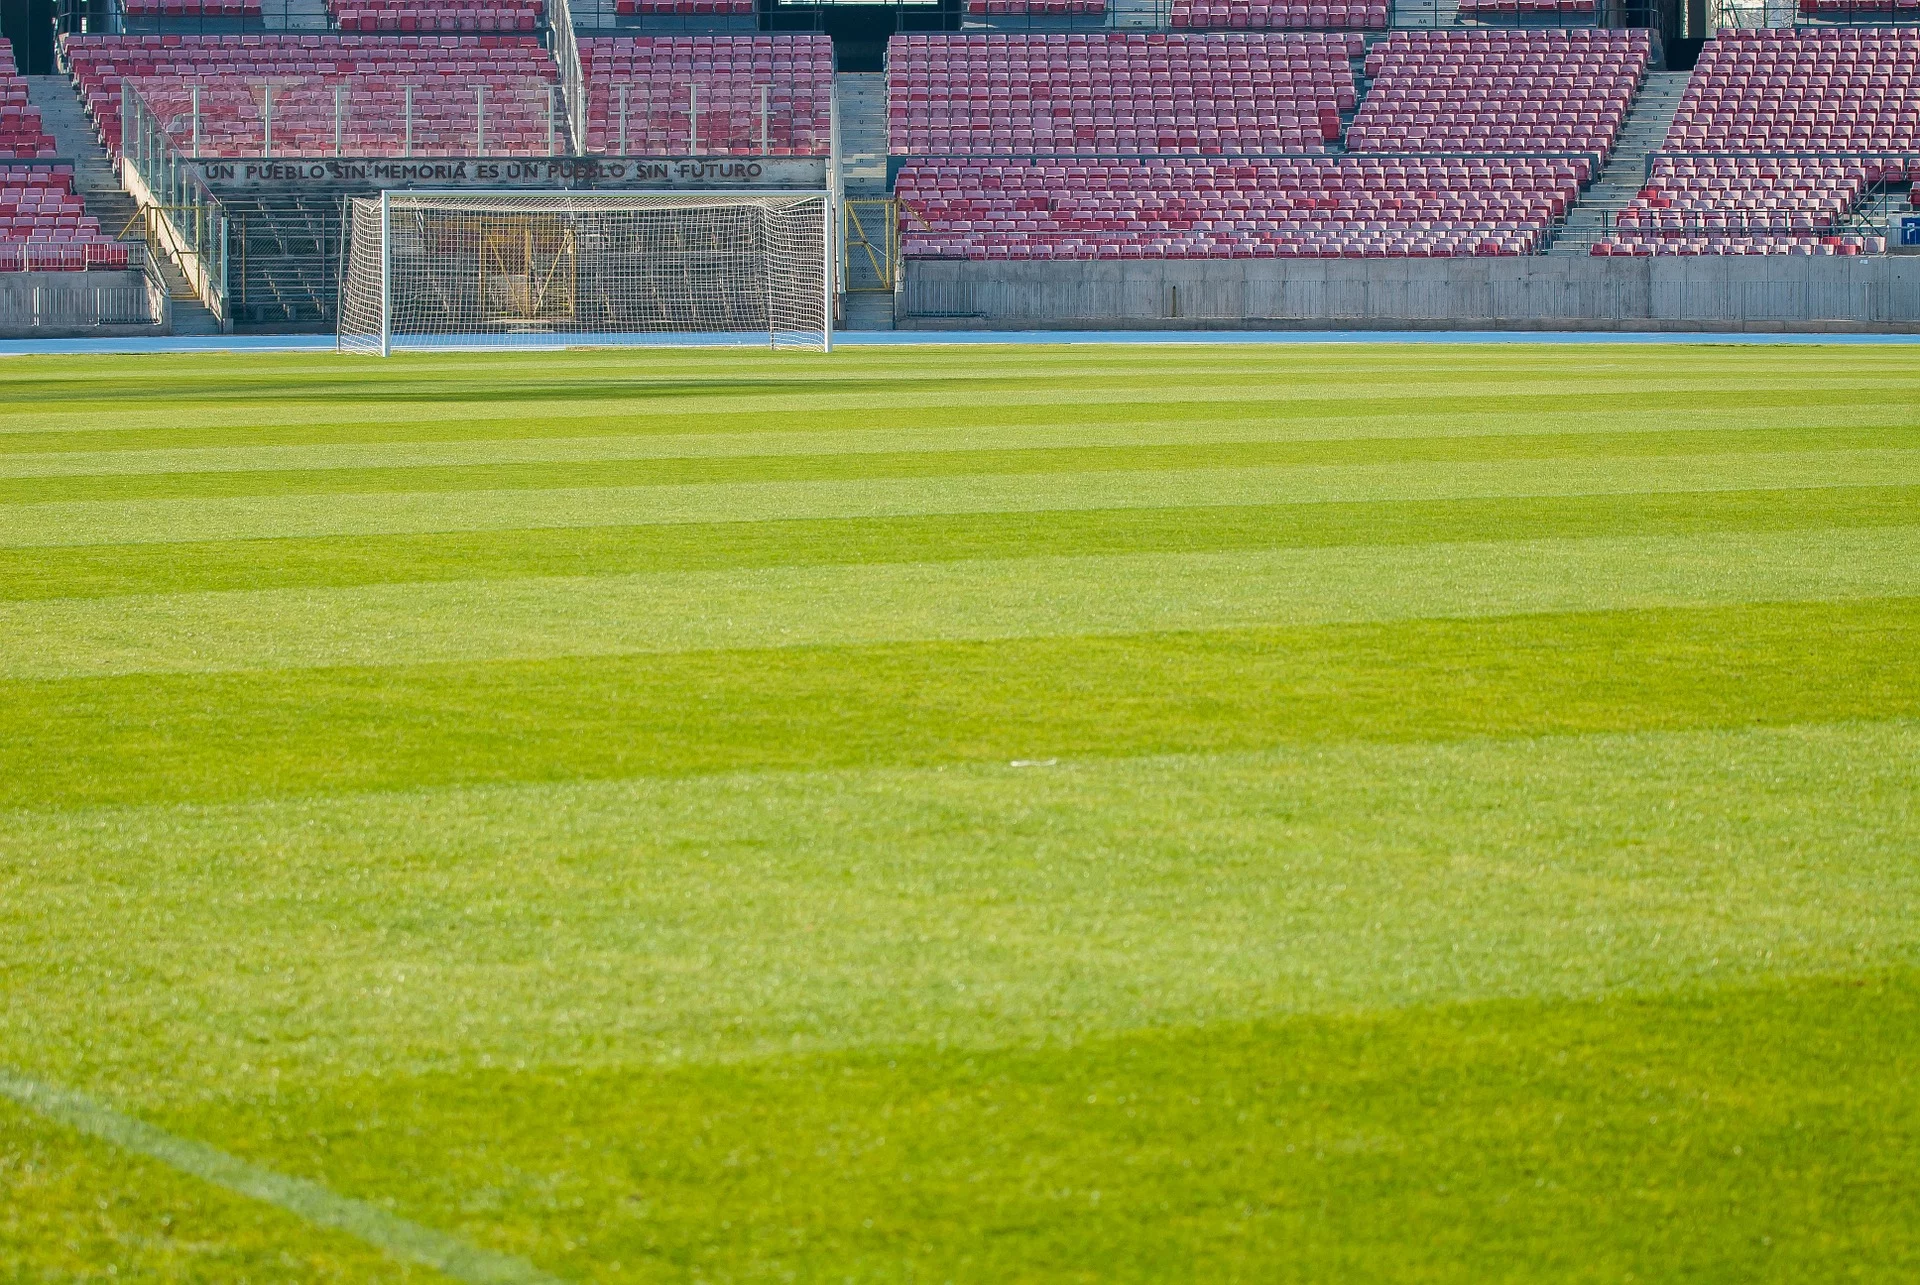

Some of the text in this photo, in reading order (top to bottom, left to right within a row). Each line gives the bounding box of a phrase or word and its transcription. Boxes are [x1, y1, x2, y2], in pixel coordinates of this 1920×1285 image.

[205, 163, 762, 179] UN PUEBLO SIN MEMORIA ES UN PUEBLO SIN FUTURO
